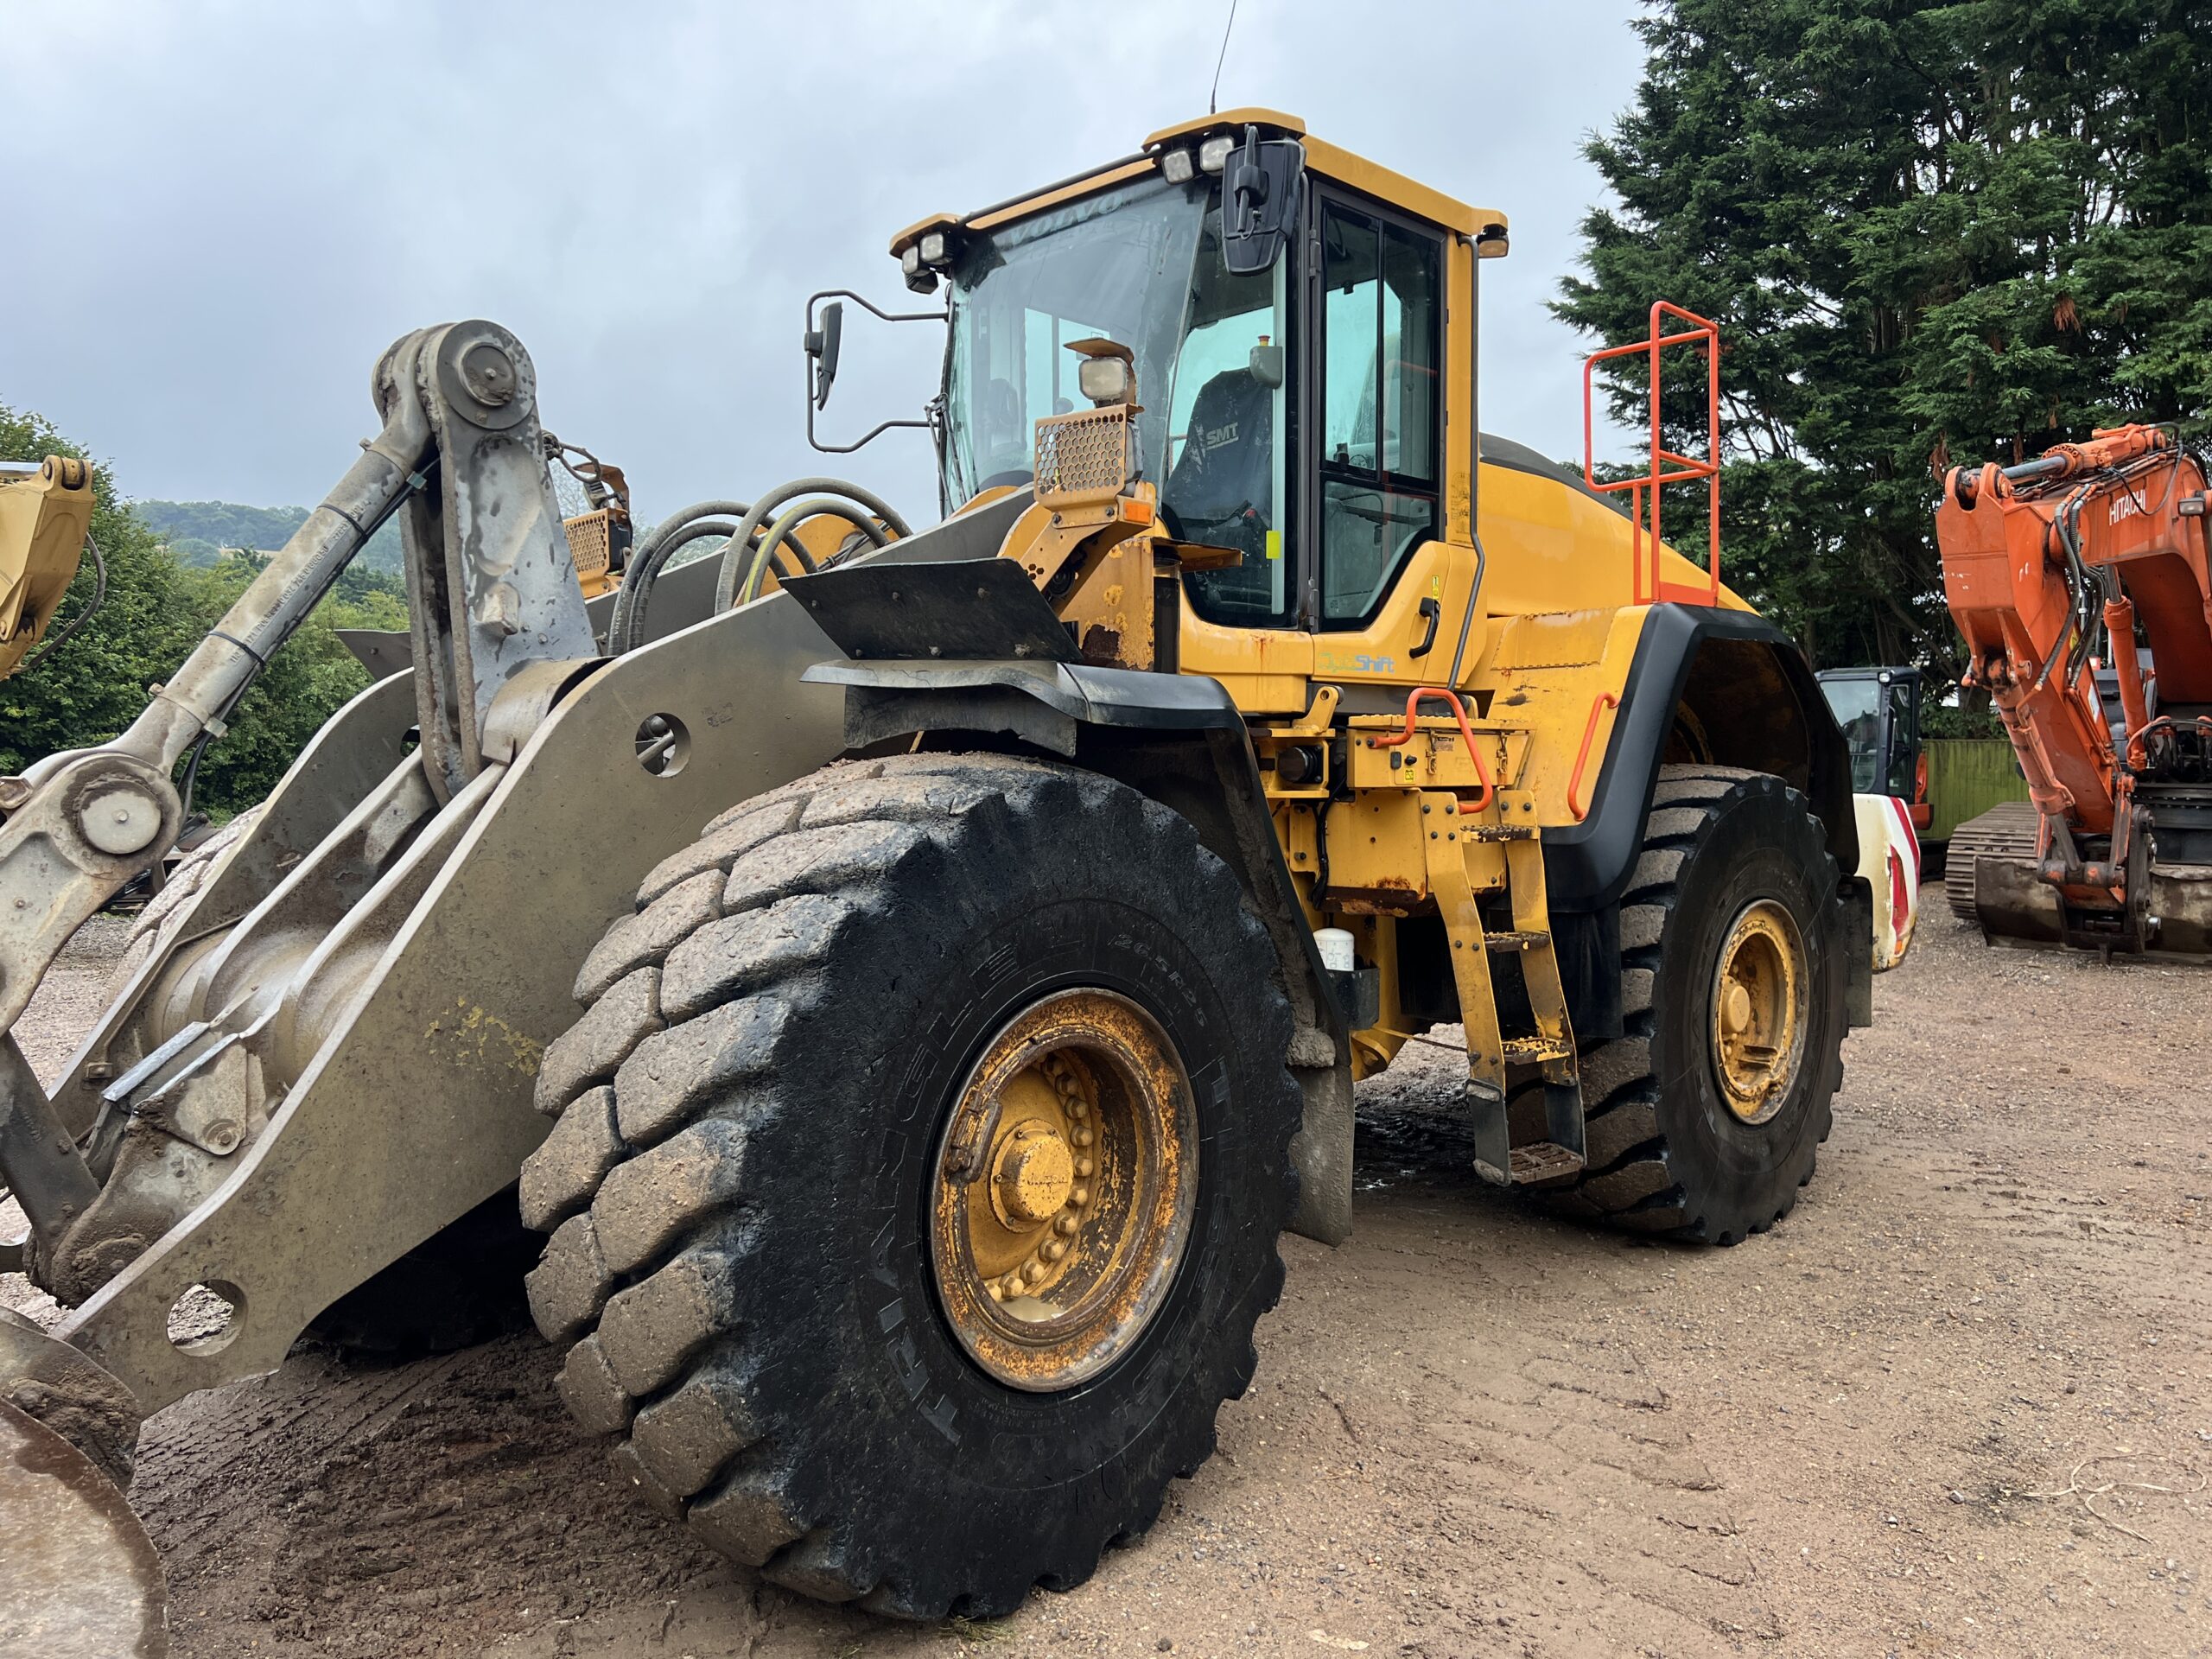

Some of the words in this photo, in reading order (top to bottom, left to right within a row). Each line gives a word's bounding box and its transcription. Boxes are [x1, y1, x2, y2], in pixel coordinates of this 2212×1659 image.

[1009, 191, 1124, 246] VOLVO
[1206, 422, 1238, 446] SMT
[2108, 488, 2146, 526] HITACHI
[868, 944, 1020, 1447] TRIANGLE
